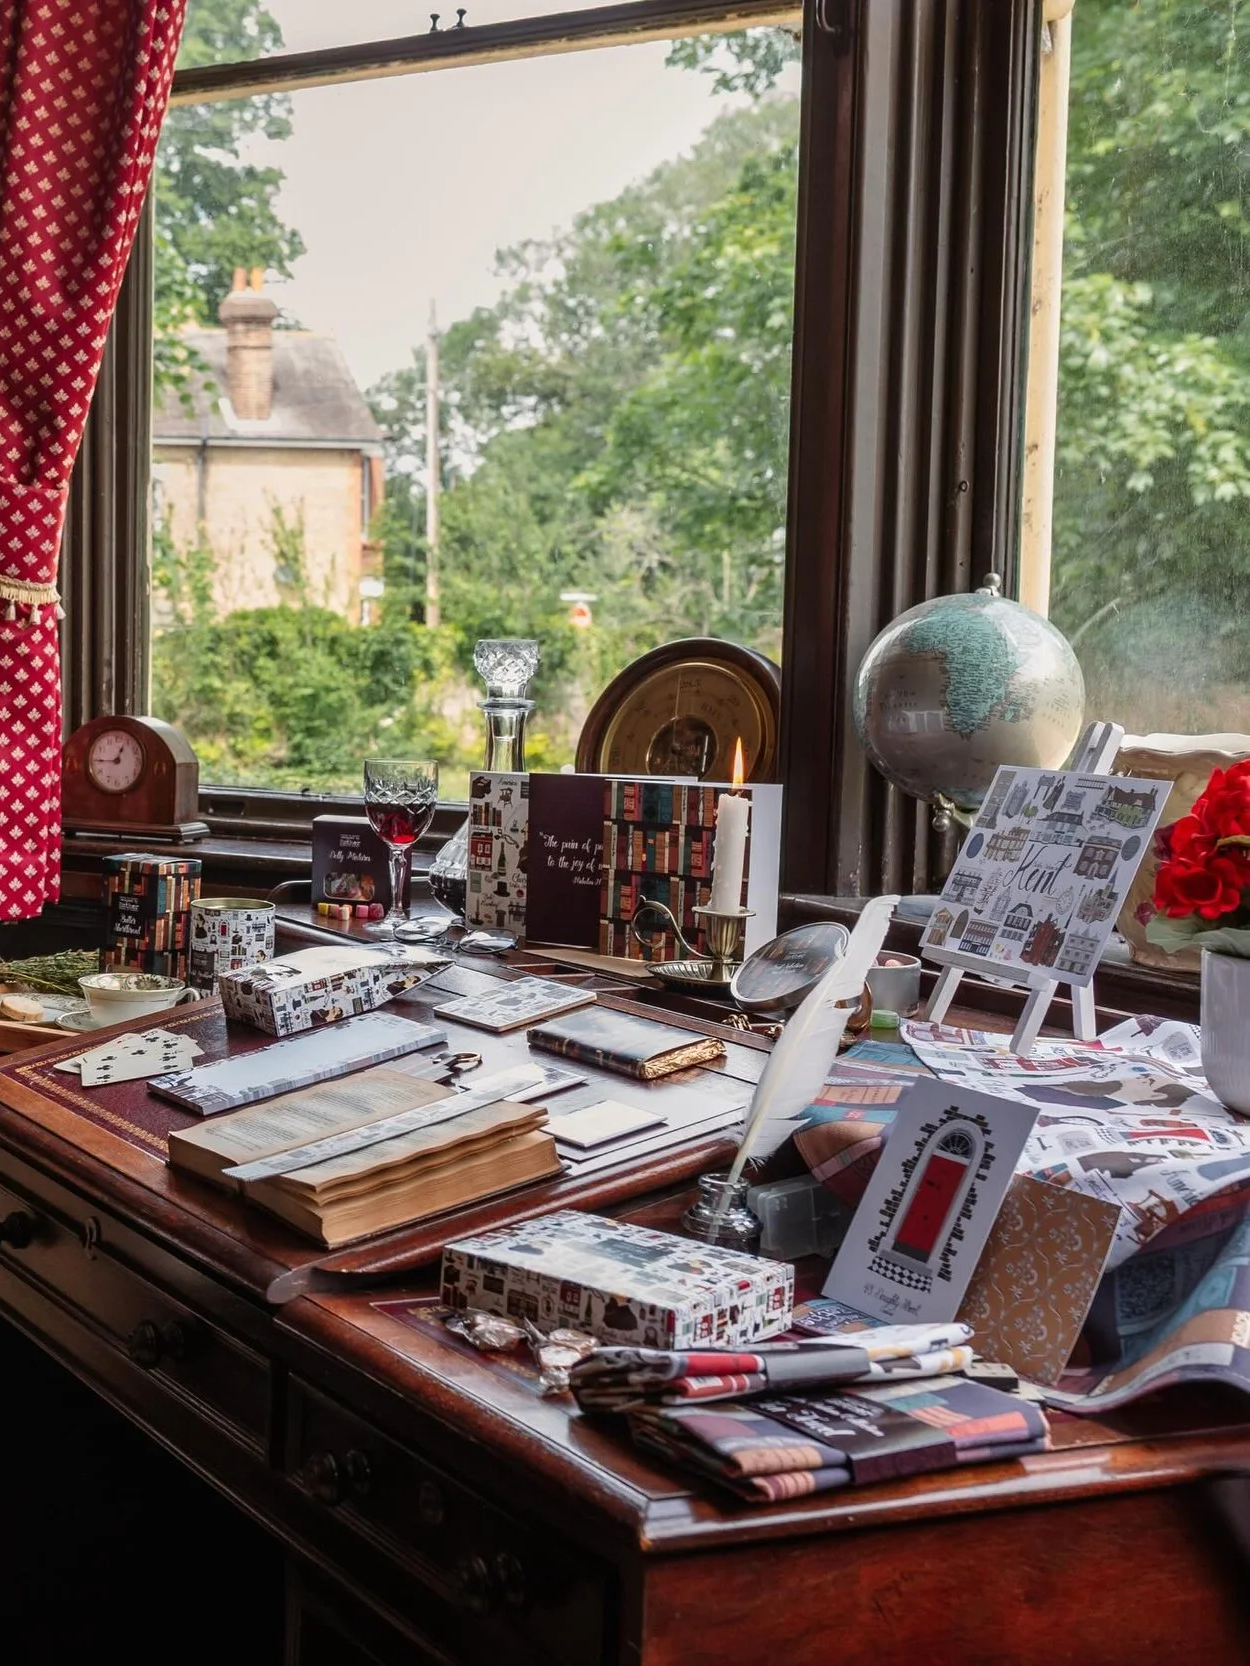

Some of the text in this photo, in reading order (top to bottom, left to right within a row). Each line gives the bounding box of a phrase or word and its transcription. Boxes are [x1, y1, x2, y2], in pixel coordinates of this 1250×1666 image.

[561, 840, 579, 853] pain
[547, 855, 555, 867] to
[558, 856, 569, 869] the
[1002, 843, 1073, 896] Kent
